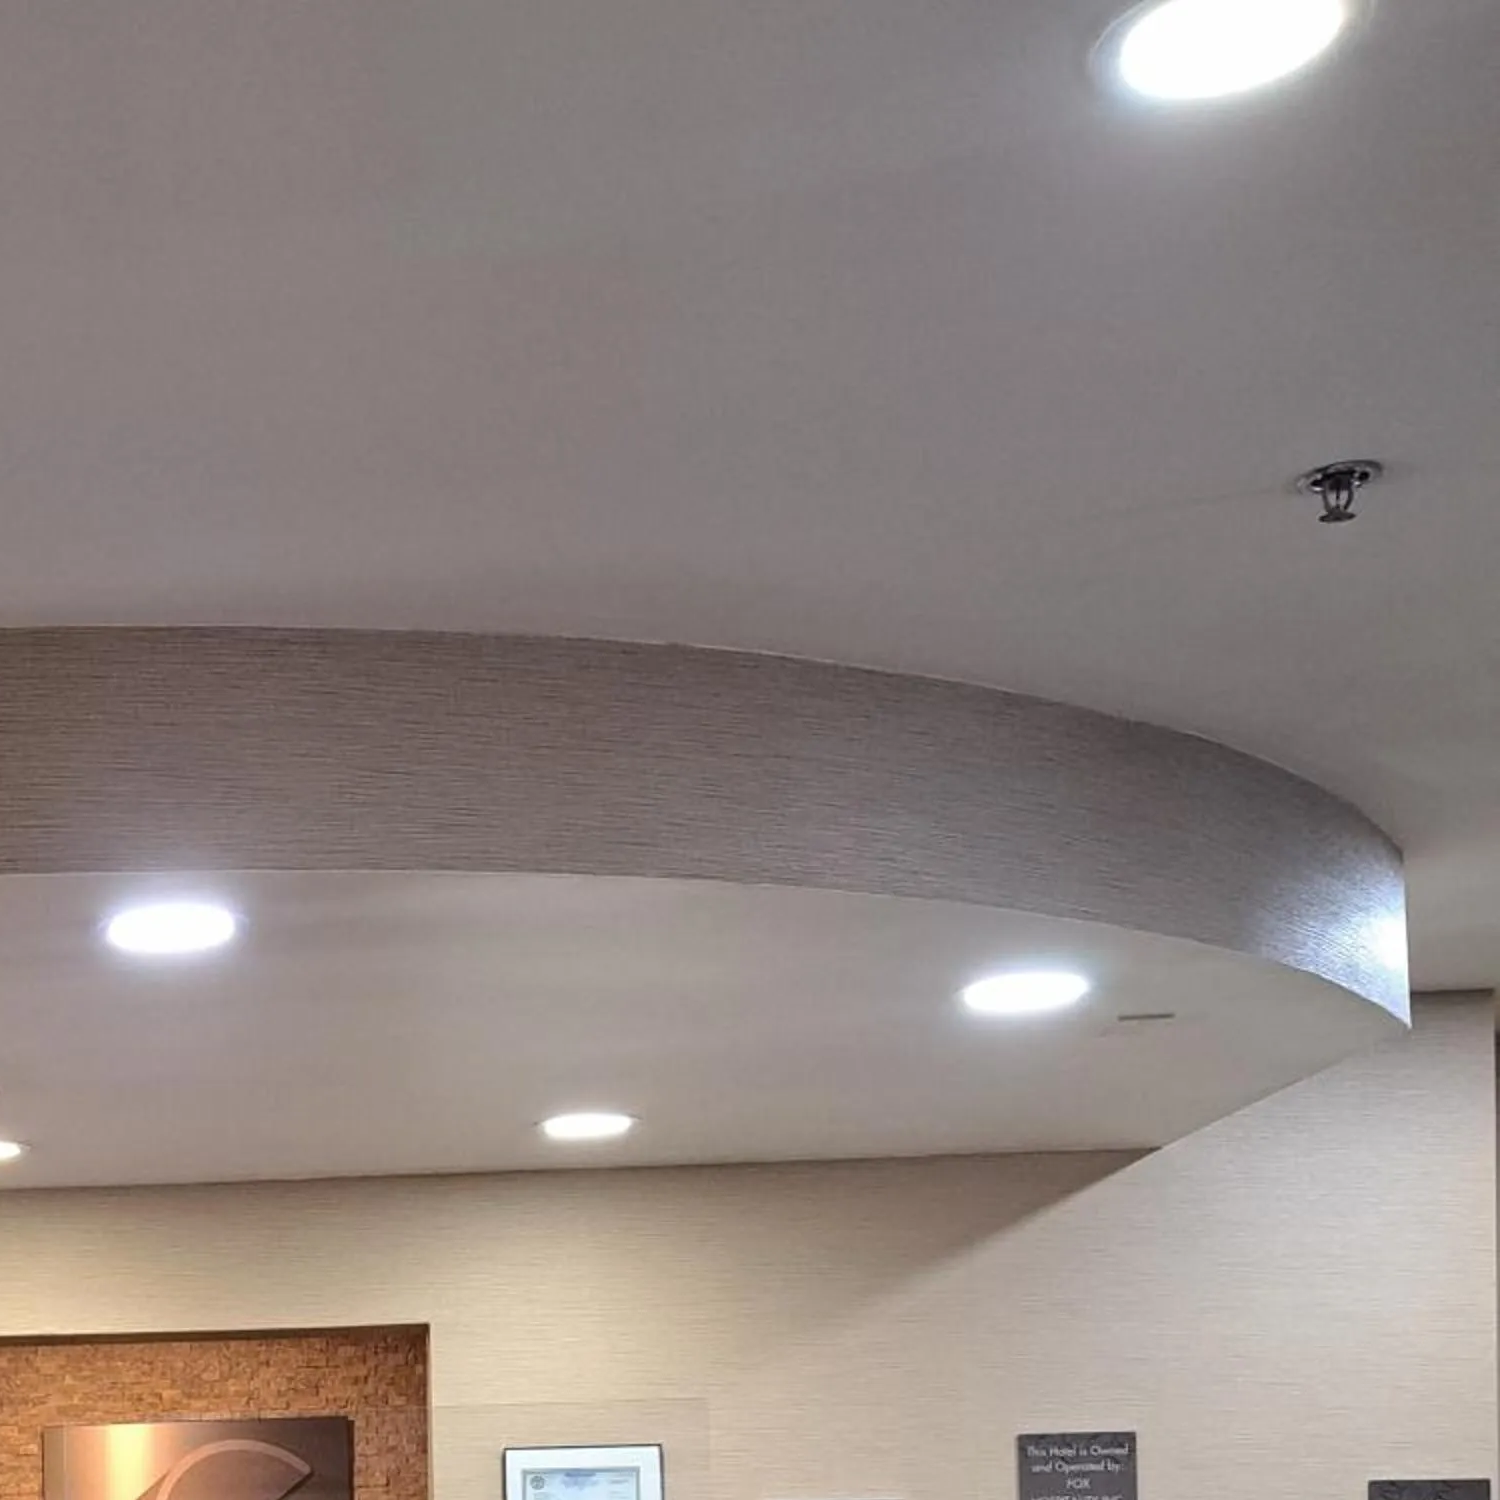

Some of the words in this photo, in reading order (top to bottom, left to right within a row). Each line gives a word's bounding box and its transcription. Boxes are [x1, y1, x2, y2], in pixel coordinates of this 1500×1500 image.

[1026, 1445, 1047, 1457] This
[1049, 1444, 1077, 1457] Hotel
[1089, 1443, 1130, 1457] Owned
[1031, 1460, 1053, 1473] and
[1054, 1459, 1105, 1474] Operated
